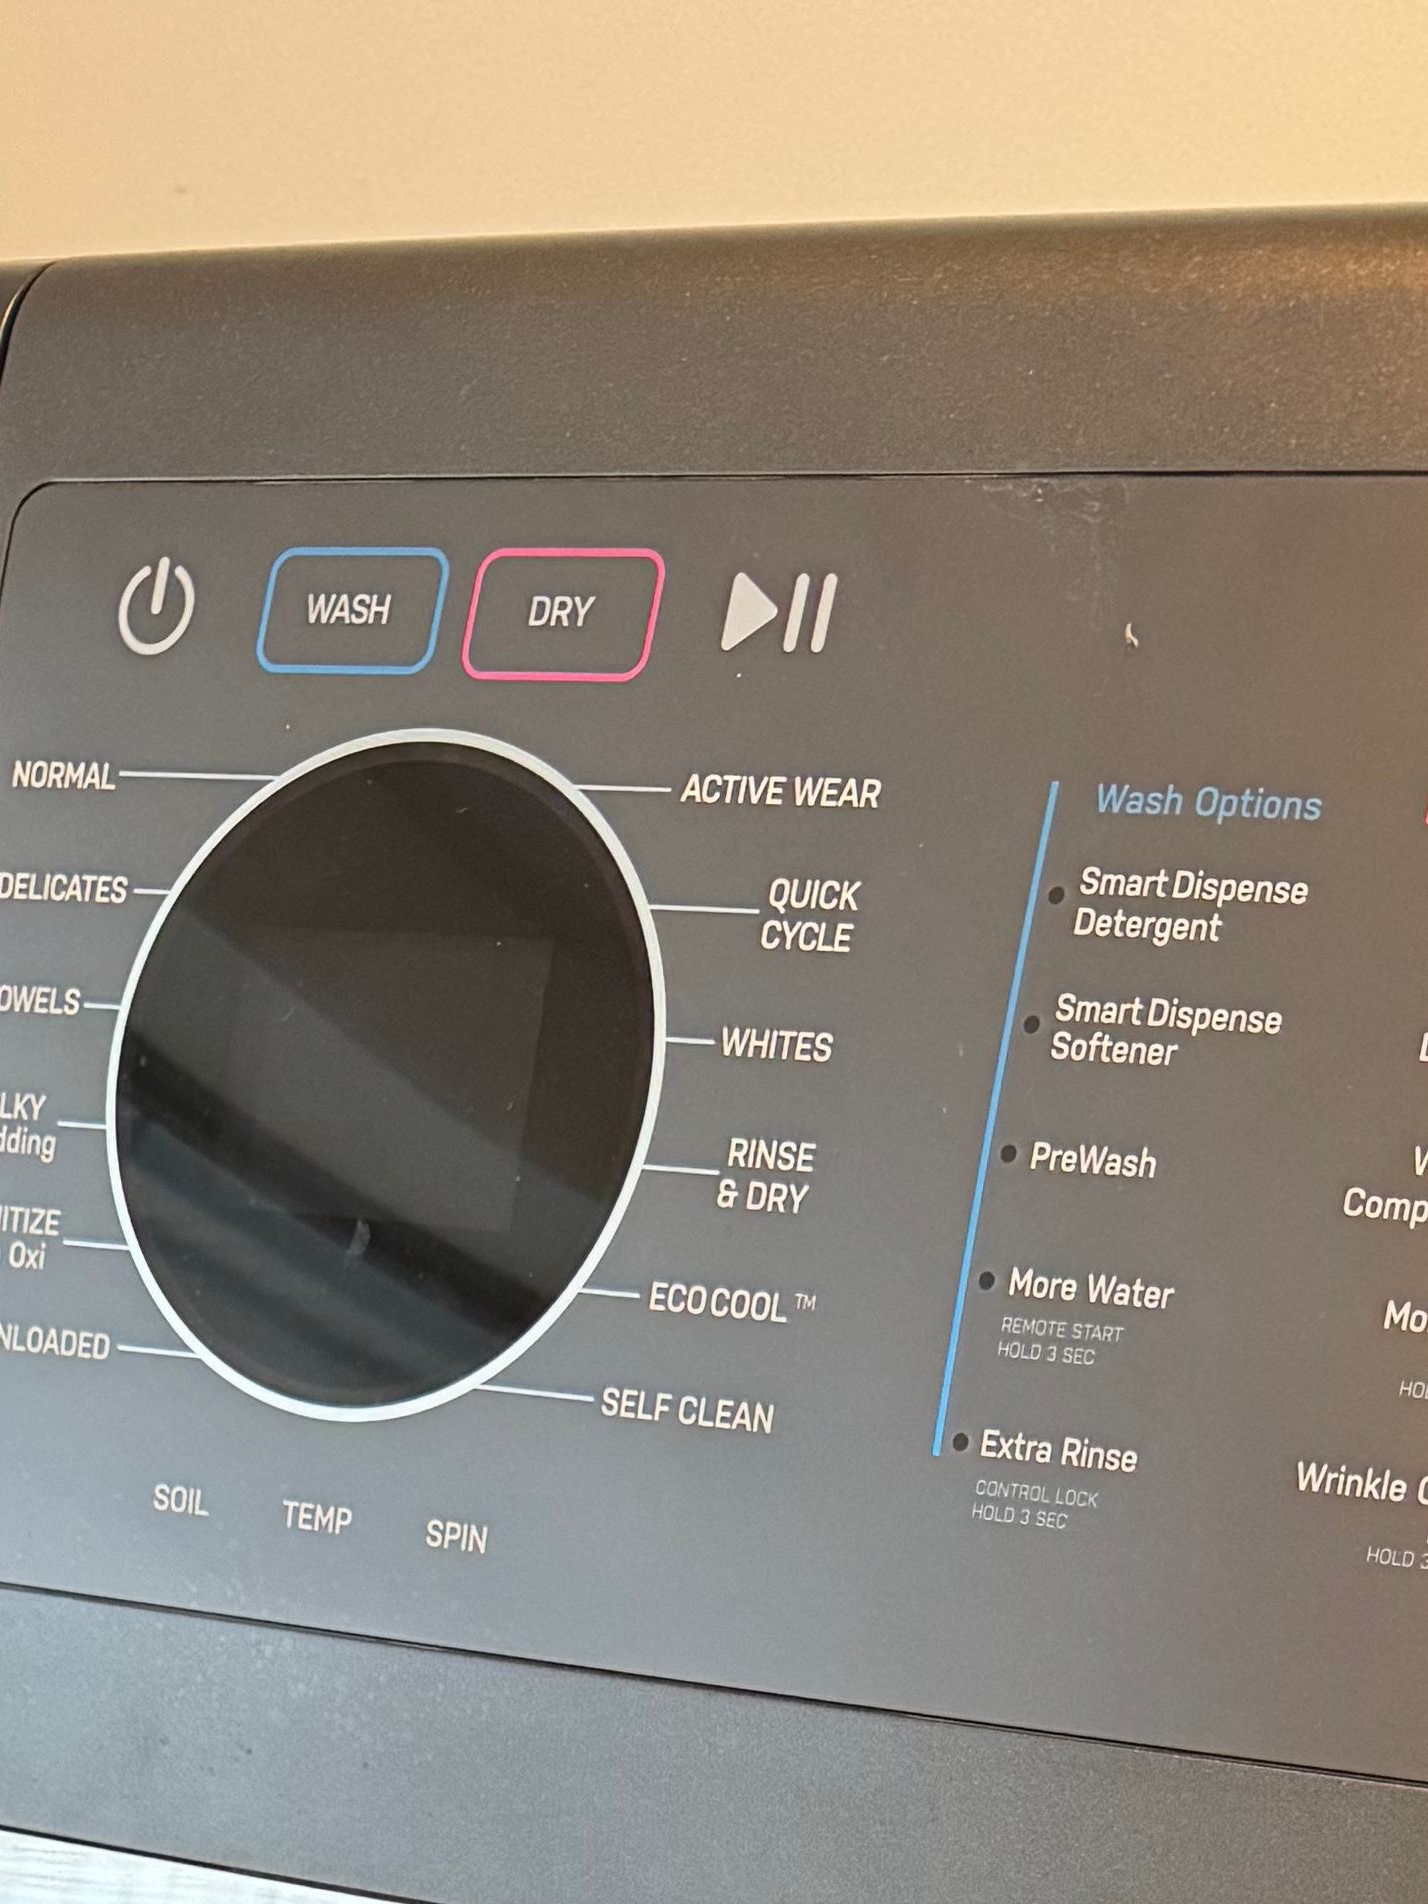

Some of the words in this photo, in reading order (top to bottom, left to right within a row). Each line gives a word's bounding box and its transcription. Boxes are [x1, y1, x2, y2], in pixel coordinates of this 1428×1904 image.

[309, 594, 391, 624] WASH
[529, 596, 596, 626] DRY
[13, 760, 115, 790] NORMAL
[680, 774, 787, 805] ACTIVE
[795, 776, 881, 808] WEAR
[1099, 784, 1182, 814] Wash
[1196, 787, 1322, 825] Options
[769, 878, 861, 914] QUICK
[1080, 866, 1169, 897] Smart
[1172, 870, 1308, 907] Dispense
[761, 920, 854, 952] CYCLE
[1074, 907, 1222, 946] Detergent
[1056, 993, 1143, 1025] Smart
[1148, 998, 1282, 1036] Dispense
[723, 1027, 833, 1062] WHITES
[1051, 1031, 1178, 1065] Softener
[728, 1138, 816, 1172] RINSE
[1031, 1142, 1156, 1178] PreWash
[717, 1179, 738, 1208] &
[747, 1181, 809, 1213] DRY
[9, 1241, 46, 1269] Oxi
[1009, 1267, 1077, 1300] More
[1089, 1274, 1175, 1309] Water
[1002, 1317, 1067, 1338] REMOTE
[1072, 1323, 1124, 1342] START
[998, 1341, 1041, 1360] HOLD
[1047, 1346, 1057, 1361] 3
[1063, 1347, 1095, 1365] SEC
[602, 1387, 672, 1421] SELF
[679, 1396, 774, 1433] CLEAN
[981, 1429, 1051, 1463] Extra
[1061, 1437, 1137, 1472] Rinse
[976, 1480, 1049, 1503] CONTROL
[1056, 1489, 1098, 1507] LOCK
[1298, 1461, 1407, 1501] Wrinkle
[154, 1483, 209, 1516] SOIL
[972, 1504, 1014, 1522] HOLD
[1020, 1509, 1030, 1524] 3
[1036, 1511, 1068, 1529] SEC
[283, 1500, 352, 1534] TEMP
[426, 1519, 487, 1553] SPIN
[1367, 1546, 1414, 1567] HOLD
